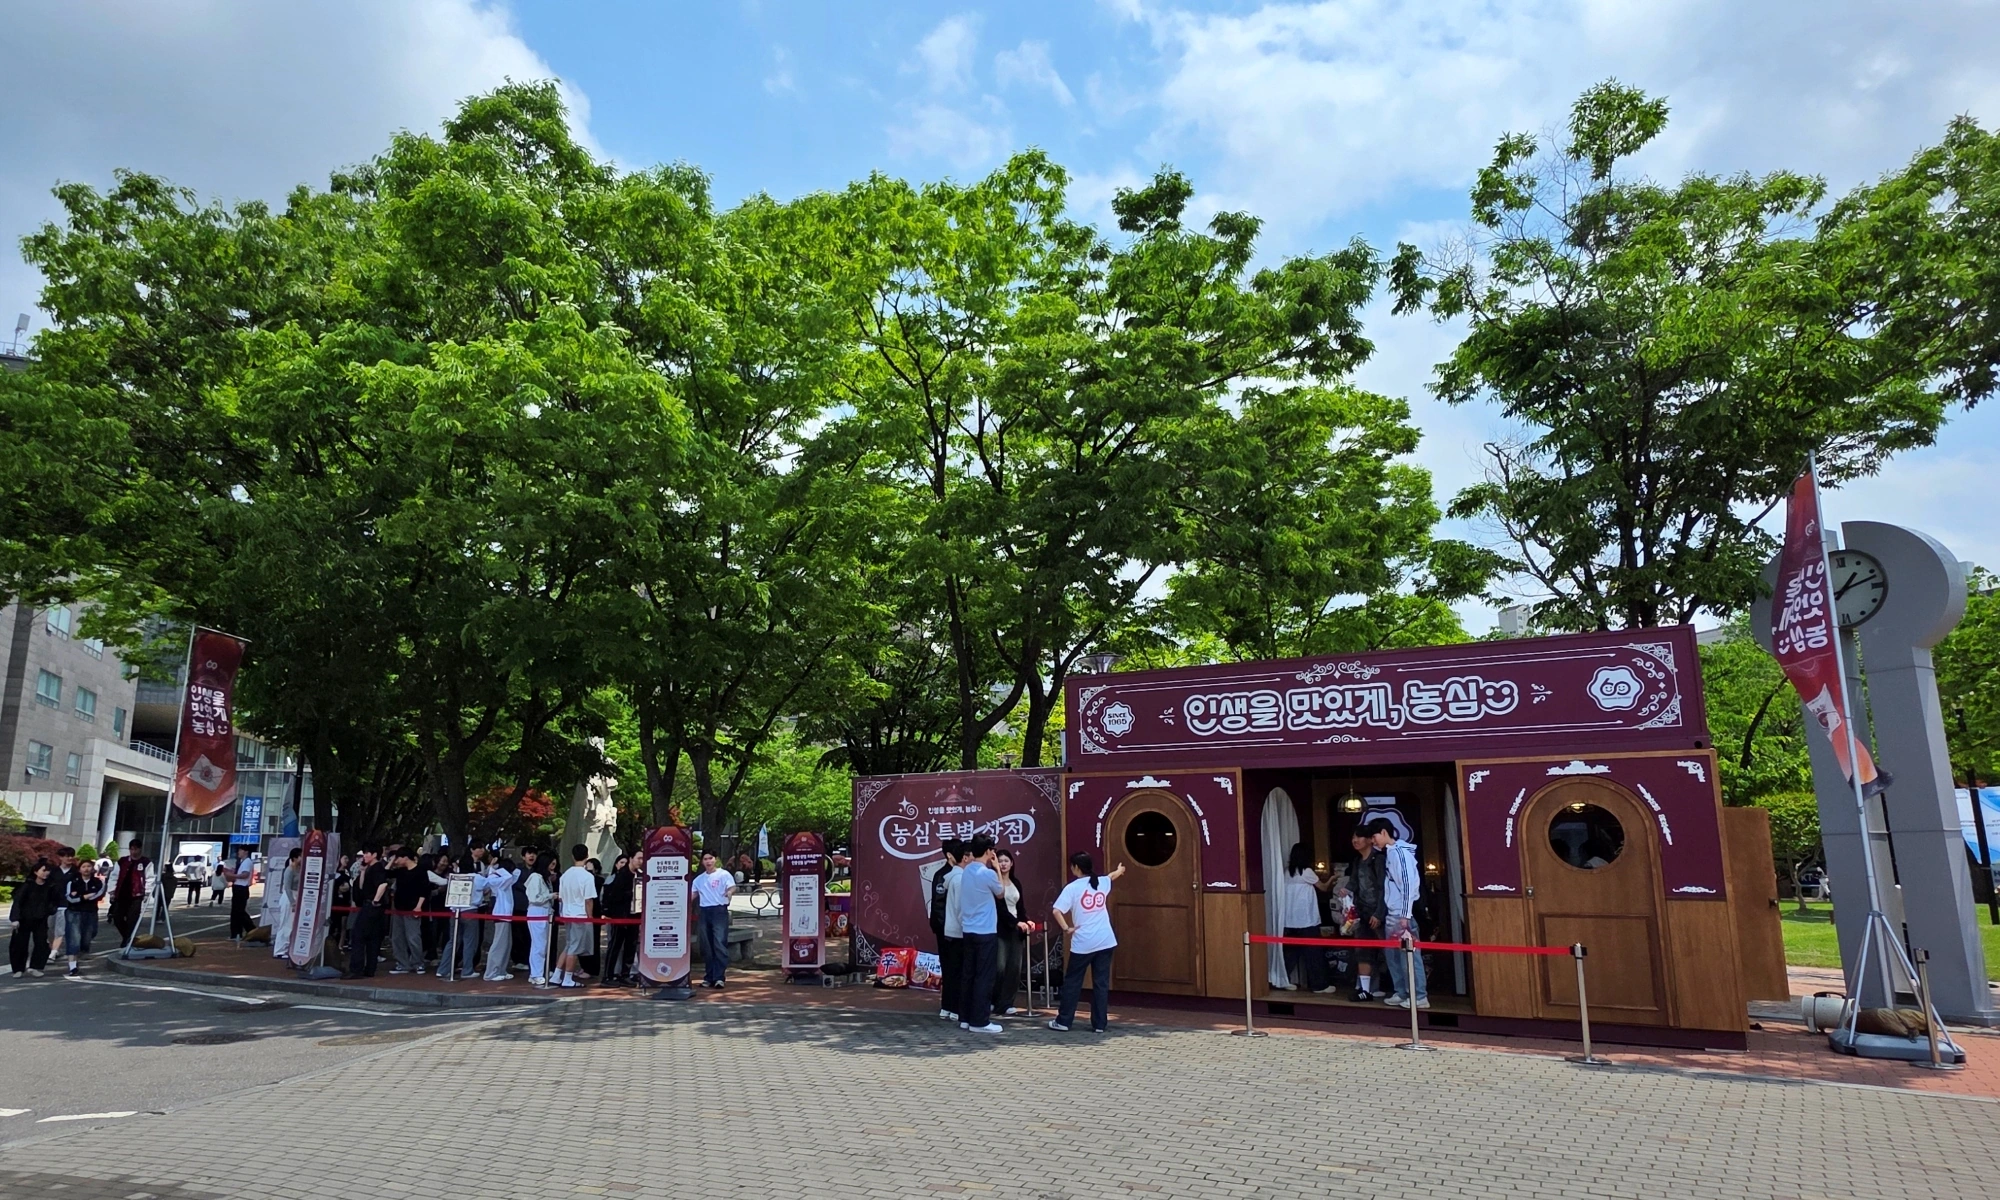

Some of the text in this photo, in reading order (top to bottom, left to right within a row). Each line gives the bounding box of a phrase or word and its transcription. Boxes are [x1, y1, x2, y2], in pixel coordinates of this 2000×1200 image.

[191, 685, 225, 706] 인생을
[1186, 680, 1480, 732] 인생을 맛있게, 농심
[192, 719, 215, 736] 농심
[1108, 718, 1127, 726] 1965
[890, 819, 1024, 847] 농심 특별 상점
